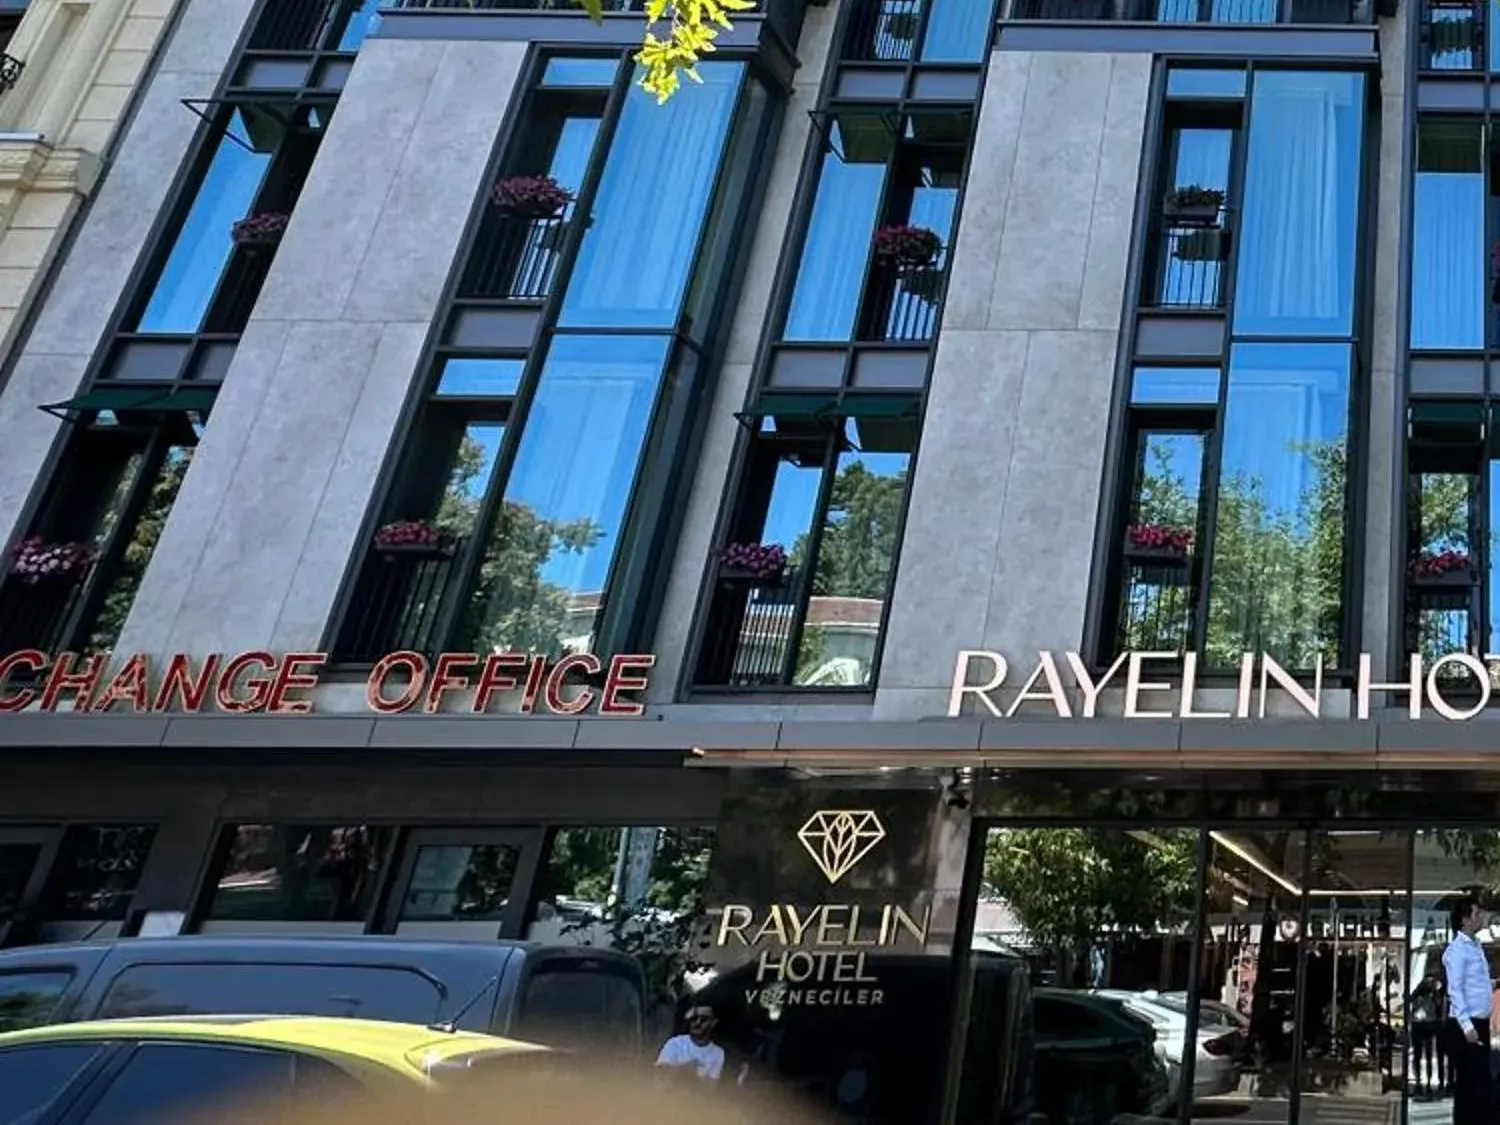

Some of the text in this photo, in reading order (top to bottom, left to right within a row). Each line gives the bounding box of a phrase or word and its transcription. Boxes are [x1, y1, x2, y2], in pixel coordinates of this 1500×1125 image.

[0, 649, 656, 716] CHANGE OFFICE
[947, 650, 1323, 718] RAYELIN
[716, 904, 931, 947] RAYELIN
[756, 950, 878, 982] HOTEL
